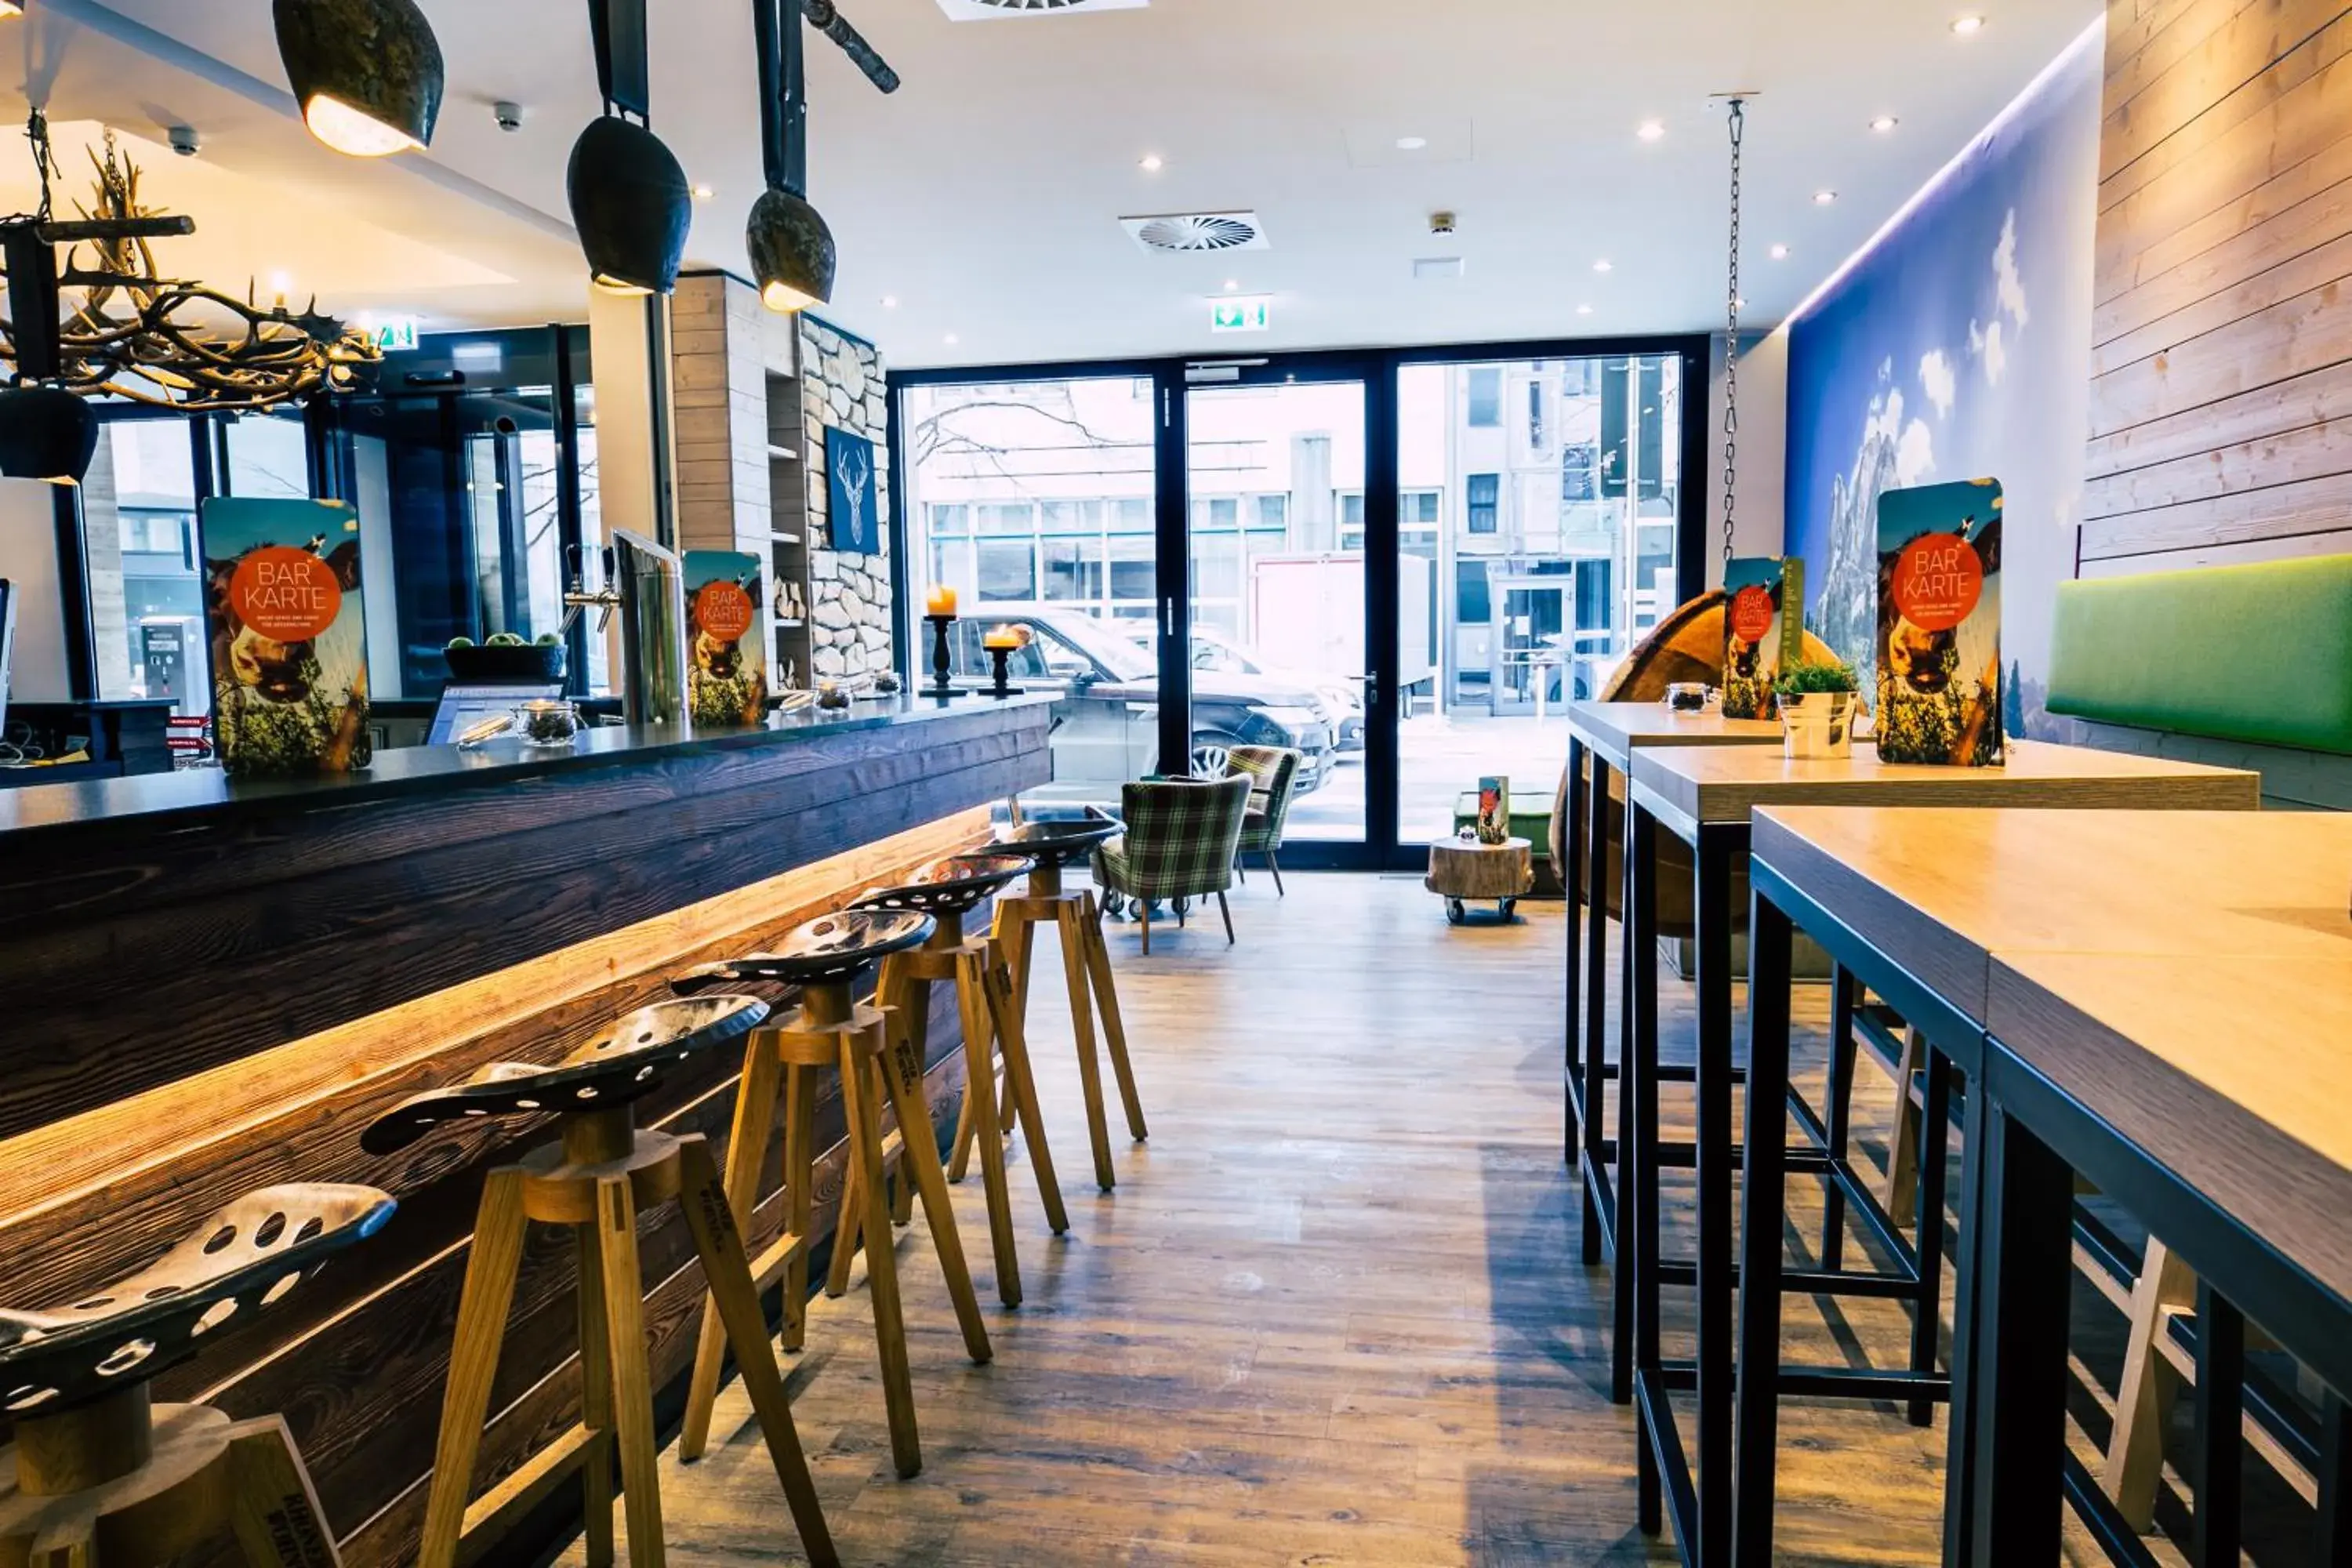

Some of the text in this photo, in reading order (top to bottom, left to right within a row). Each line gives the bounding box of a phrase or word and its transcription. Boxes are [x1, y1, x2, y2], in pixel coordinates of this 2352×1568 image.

[1915, 548, 1959, 574] BAR
[257, 562, 311, 586] BAR
[1903, 572, 1970, 599] KARTE
[244, 586, 327, 610] KARTE
[710, 590, 738, 605] BAR
[702, 606, 745, 621] KARTE
